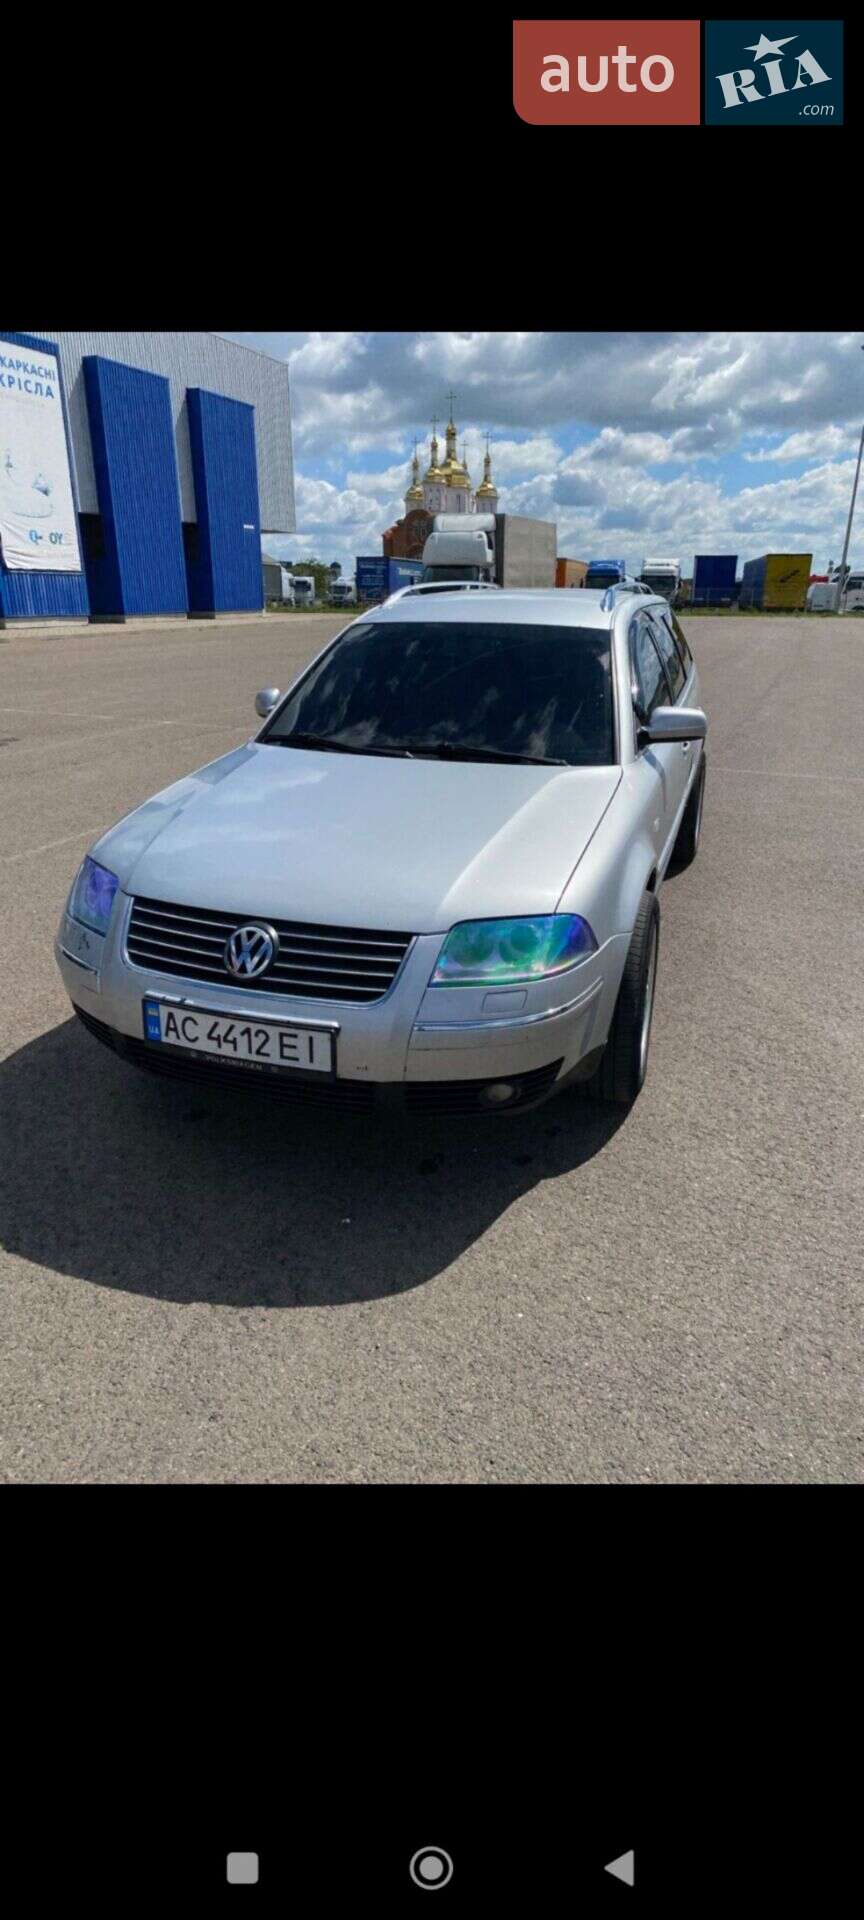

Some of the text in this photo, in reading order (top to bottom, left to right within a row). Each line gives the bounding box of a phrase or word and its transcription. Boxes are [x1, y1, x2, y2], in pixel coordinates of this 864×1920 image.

[164, 1012, 315, 1064] AC 4412 EI
